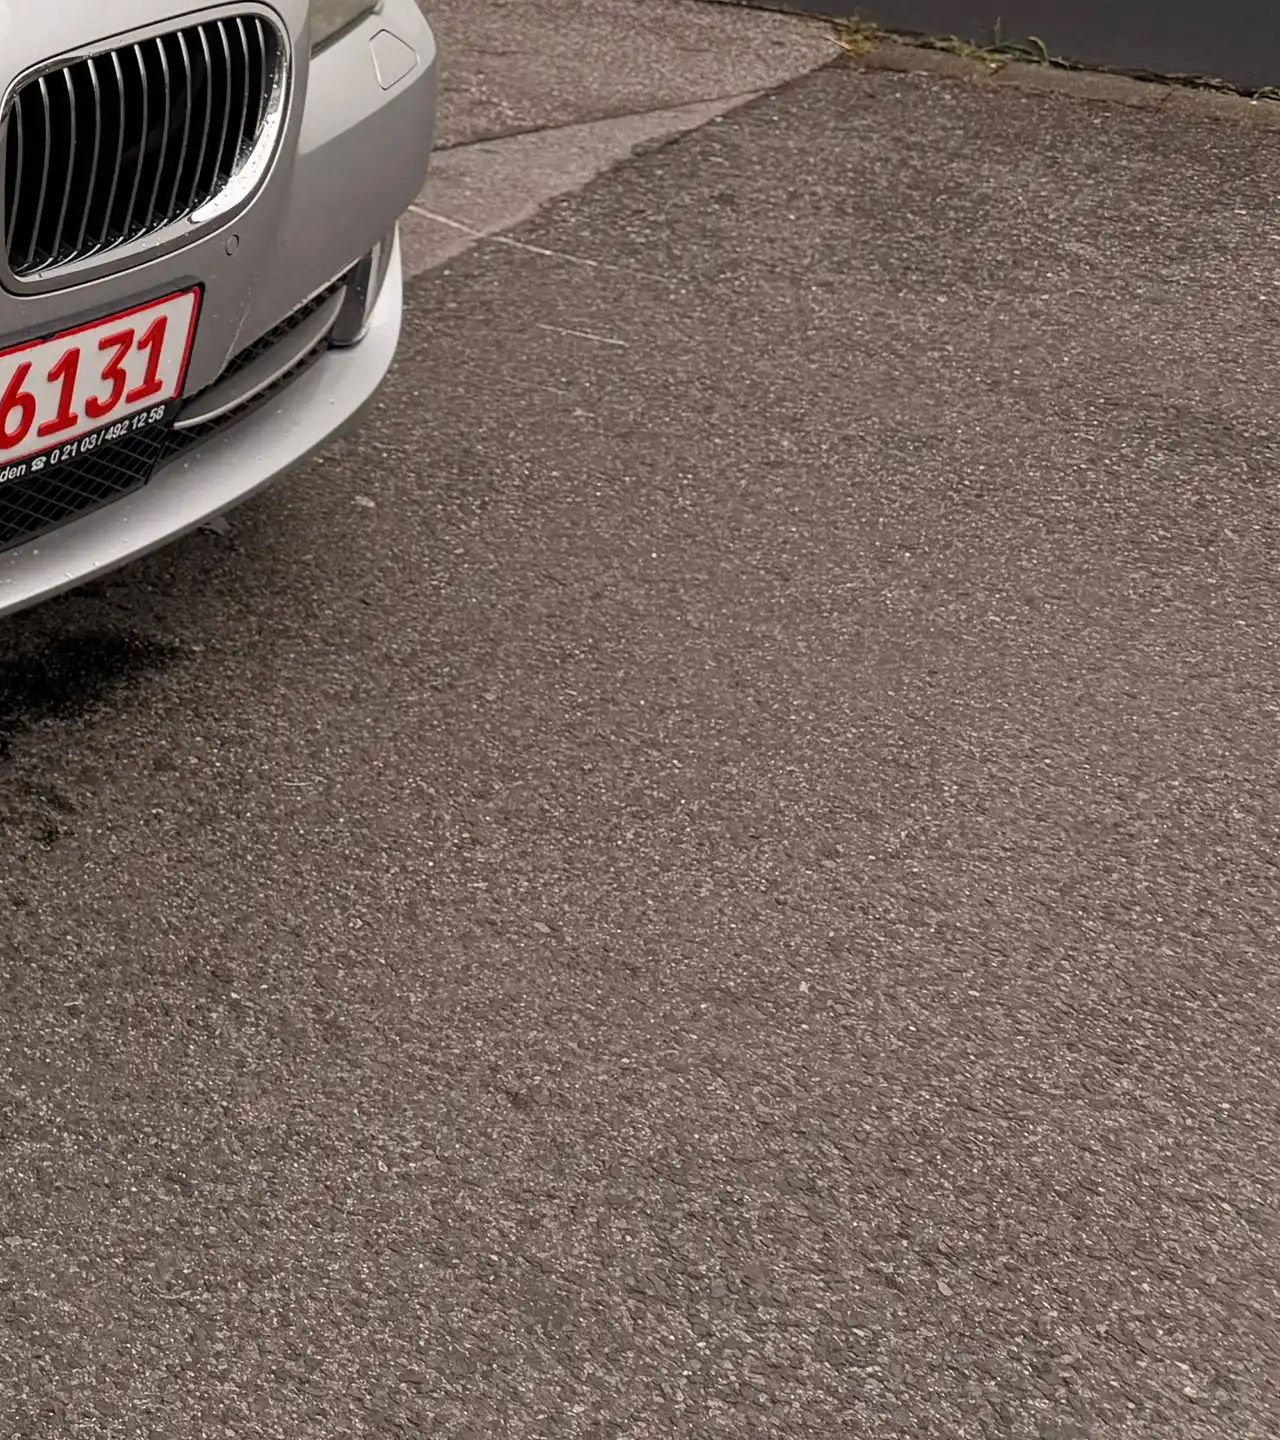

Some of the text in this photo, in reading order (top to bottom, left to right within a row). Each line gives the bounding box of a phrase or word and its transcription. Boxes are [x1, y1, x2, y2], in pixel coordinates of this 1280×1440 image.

[50, 449, 60, 465] 0
[61, 441, 78, 461] 21
[80, 433, 97, 452] 03
[105, 419, 129, 441] 492
[131, 412, 148, 430] 12
[148, 404, 166, 423] 58
